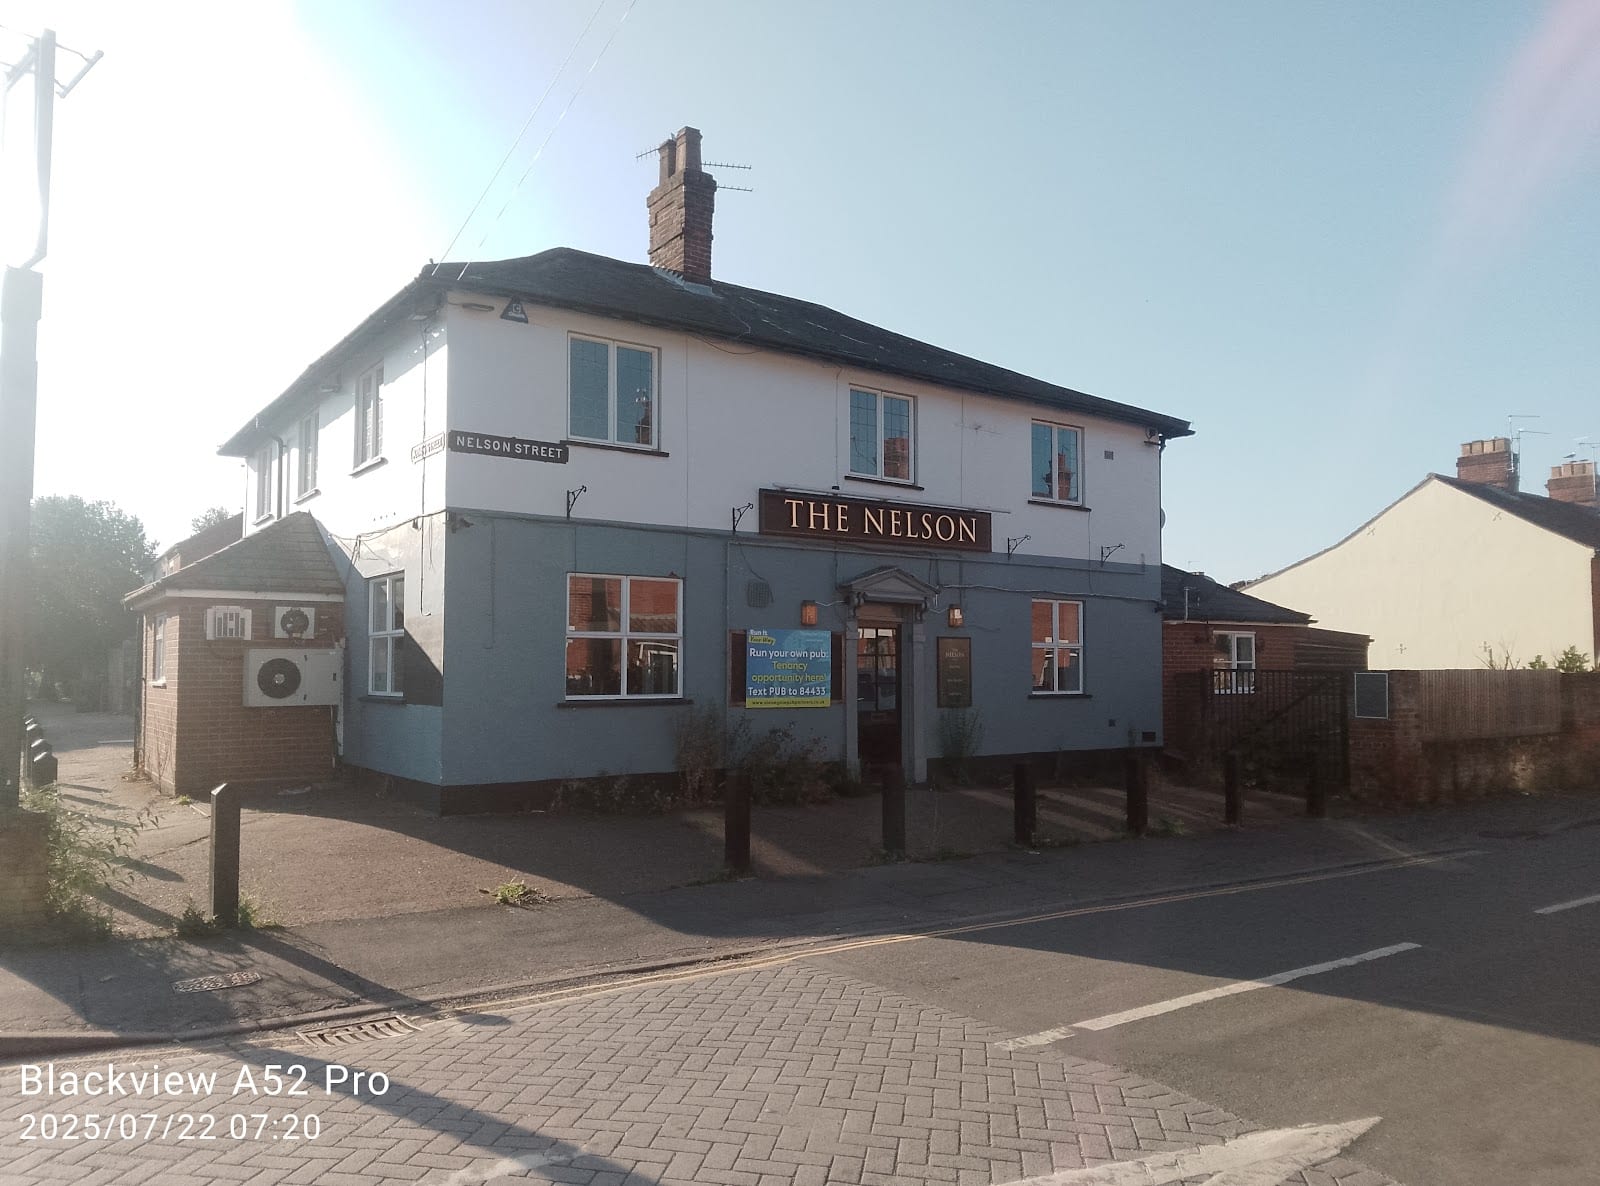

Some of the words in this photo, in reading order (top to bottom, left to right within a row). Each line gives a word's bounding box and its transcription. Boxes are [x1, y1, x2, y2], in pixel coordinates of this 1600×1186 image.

[456, 436, 511, 453] NELSON
[514, 443, 563, 459] STREET
[784, 498, 850, 533] THE
[863, 506, 978, 544] NELSON
[749, 648, 767, 657] Run
[768, 650, 789, 660] your
[790, 650, 808, 658] own
[772, 661, 808, 672] Tenancy
[751, 674, 804, 684] opportunity
[805, 673, 827, 682] here!
[748, 687, 768, 696] Text
[769, 687, 786, 696] PUB
[788, 687, 798, 696] to
[799, 687, 826, 696] 84433
